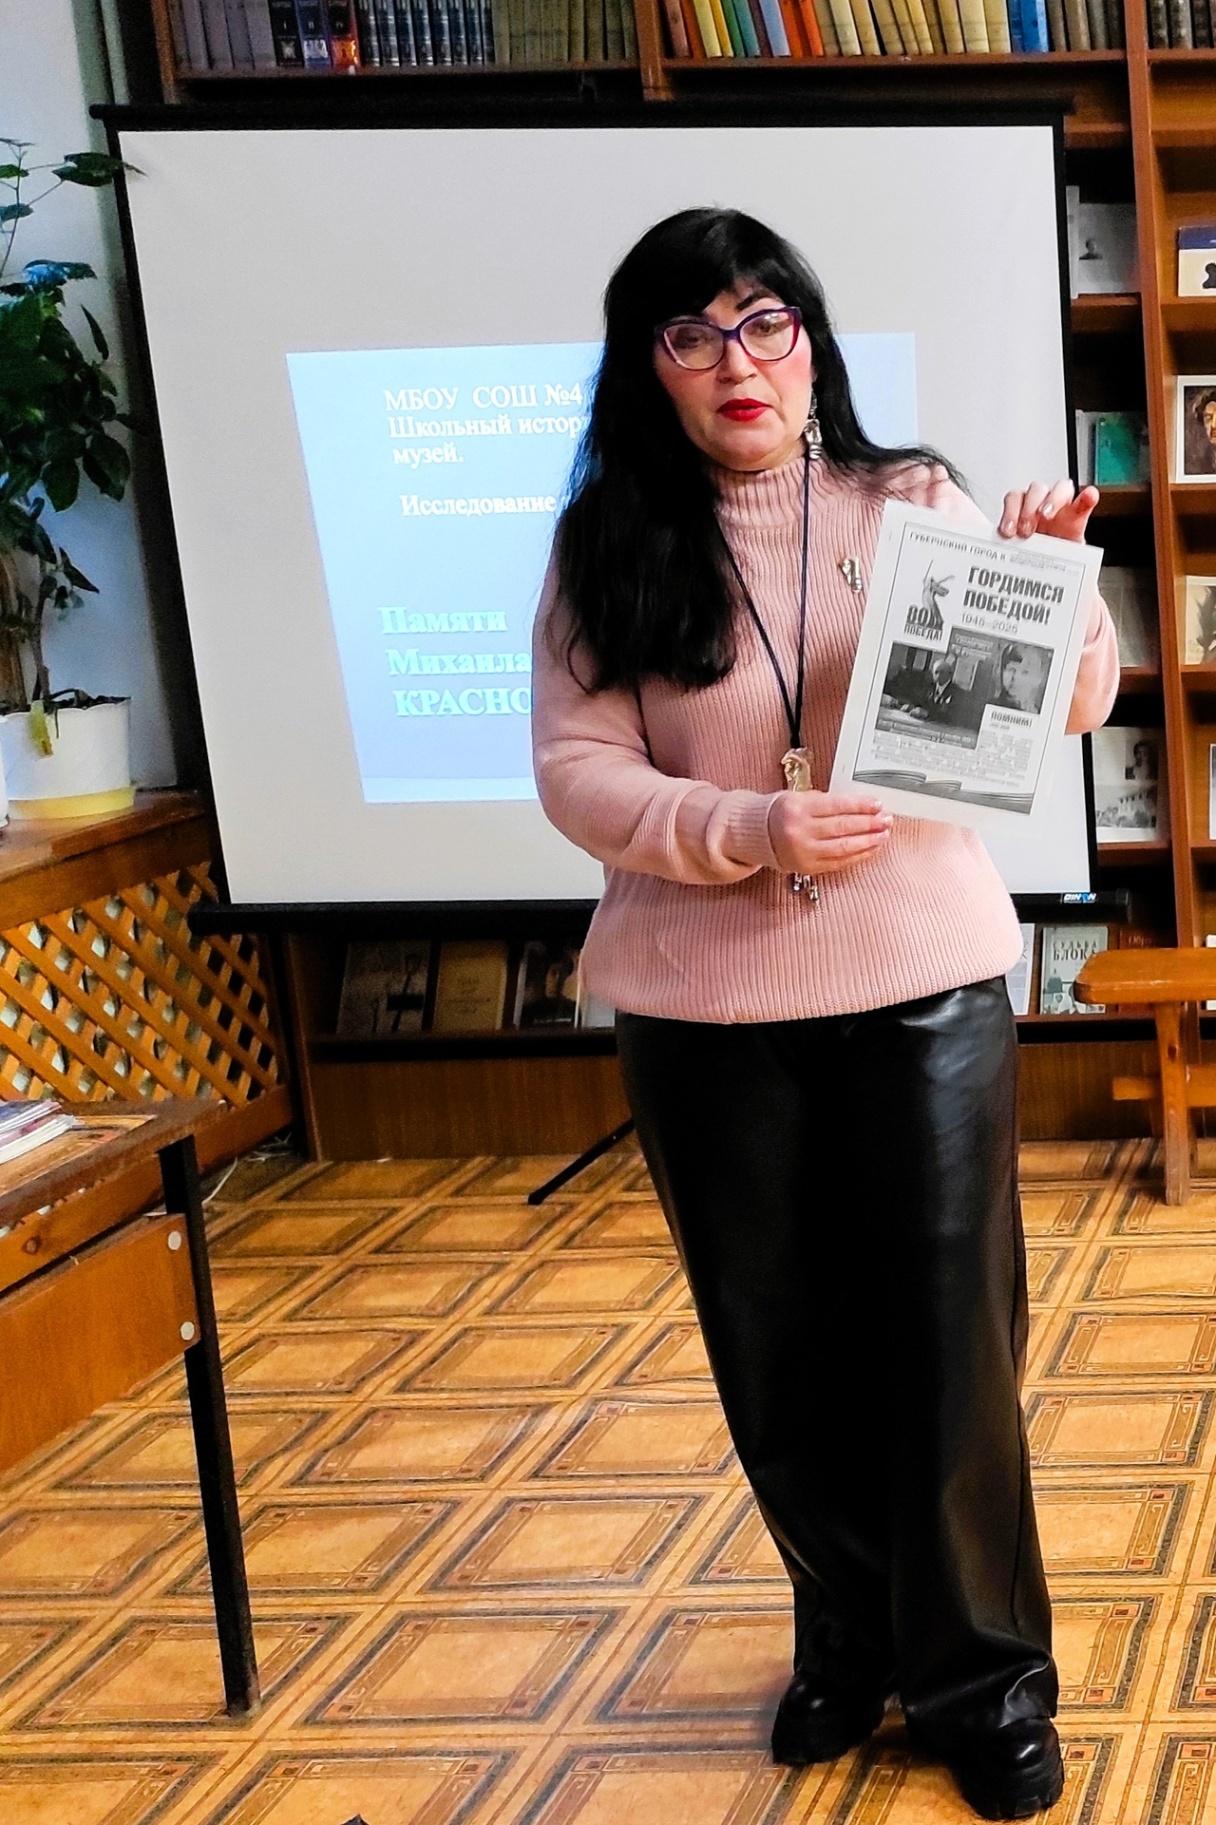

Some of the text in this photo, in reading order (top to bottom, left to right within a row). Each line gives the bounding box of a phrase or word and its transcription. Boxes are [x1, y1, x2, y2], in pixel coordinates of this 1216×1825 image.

[384, 387, 458, 411] МБОУ
[472, 385, 538, 408] СОШ
[387, 413, 590, 438] Школьный истор
[392, 442, 464, 469] музей.
[400, 495, 556, 517] Исследование
[967, 565, 1065, 603] ГОРДИМСЯ
[378, 606, 507, 634] Памяти
[963, 589, 1051, 625] ПОБЕДОЙ!
[385, 649, 531, 675] Михаила
